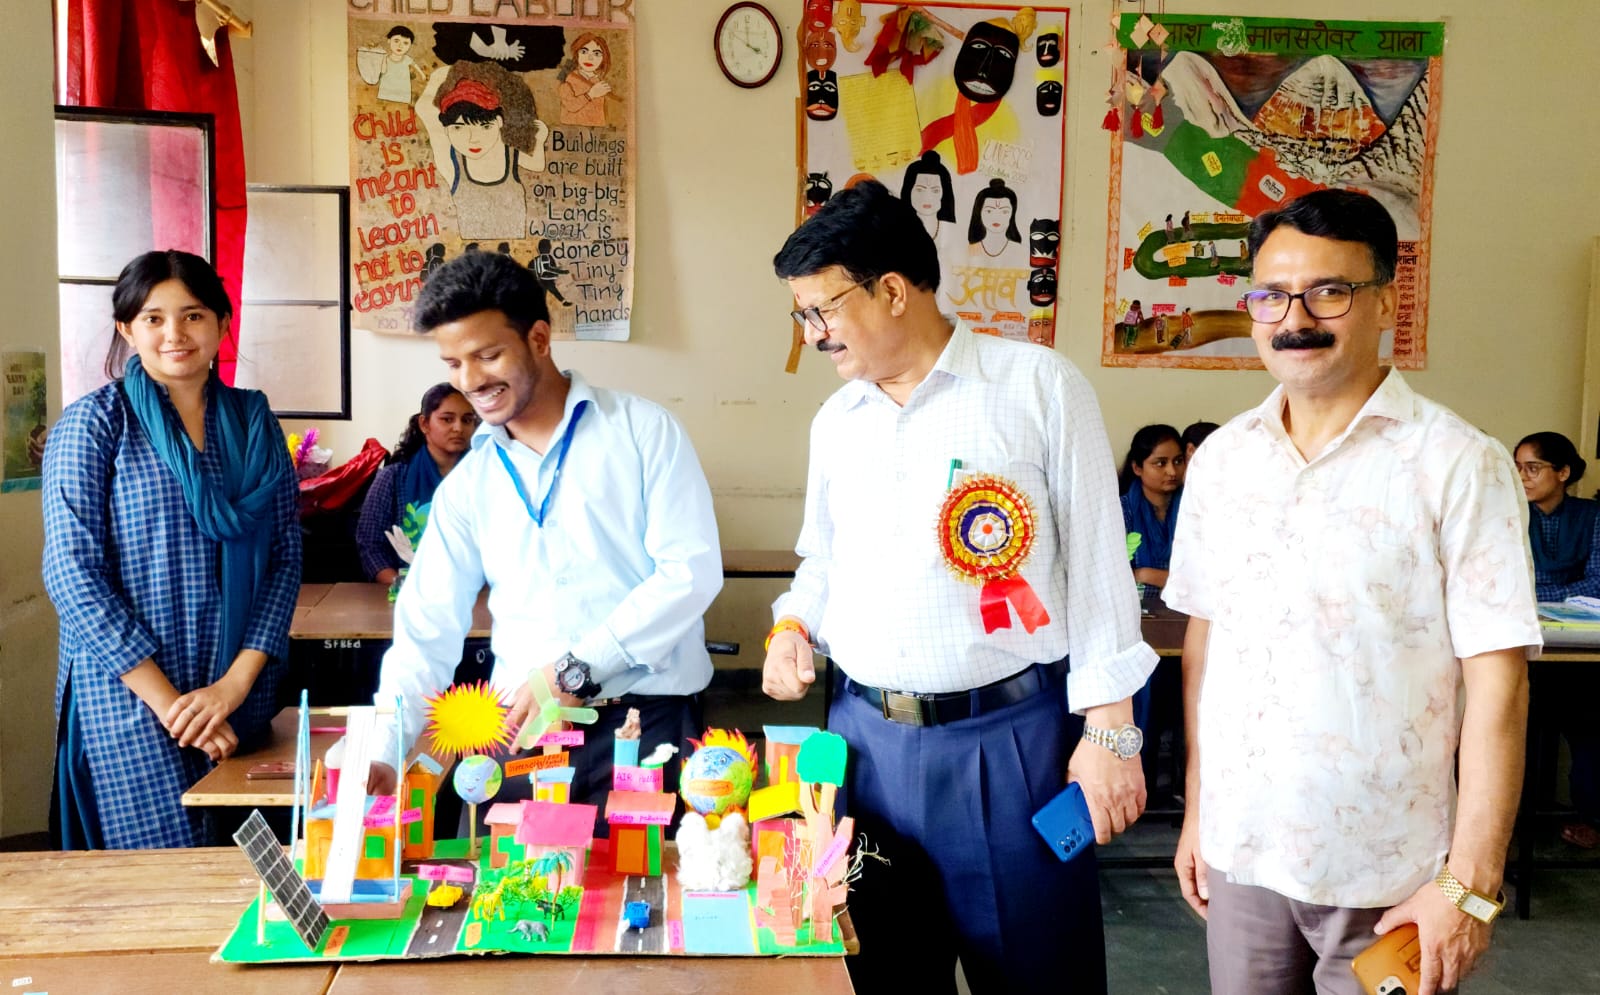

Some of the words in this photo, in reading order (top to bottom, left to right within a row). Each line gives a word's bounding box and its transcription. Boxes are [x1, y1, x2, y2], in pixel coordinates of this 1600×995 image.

[353, 109, 418, 141] Child
[380, 140, 405, 168] is
[552, 130, 625, 158] Buildings
[548, 159, 579, 176] are
[586, 155, 624, 177] built
[356, 162, 440, 202] meant
[533, 184, 556, 198] on
[388, 193, 416, 219] to
[598, 223, 612, 240] is
[354, 259, 394, 285] not
[398, 250, 424, 278] to
[575, 303, 630, 325] hands
